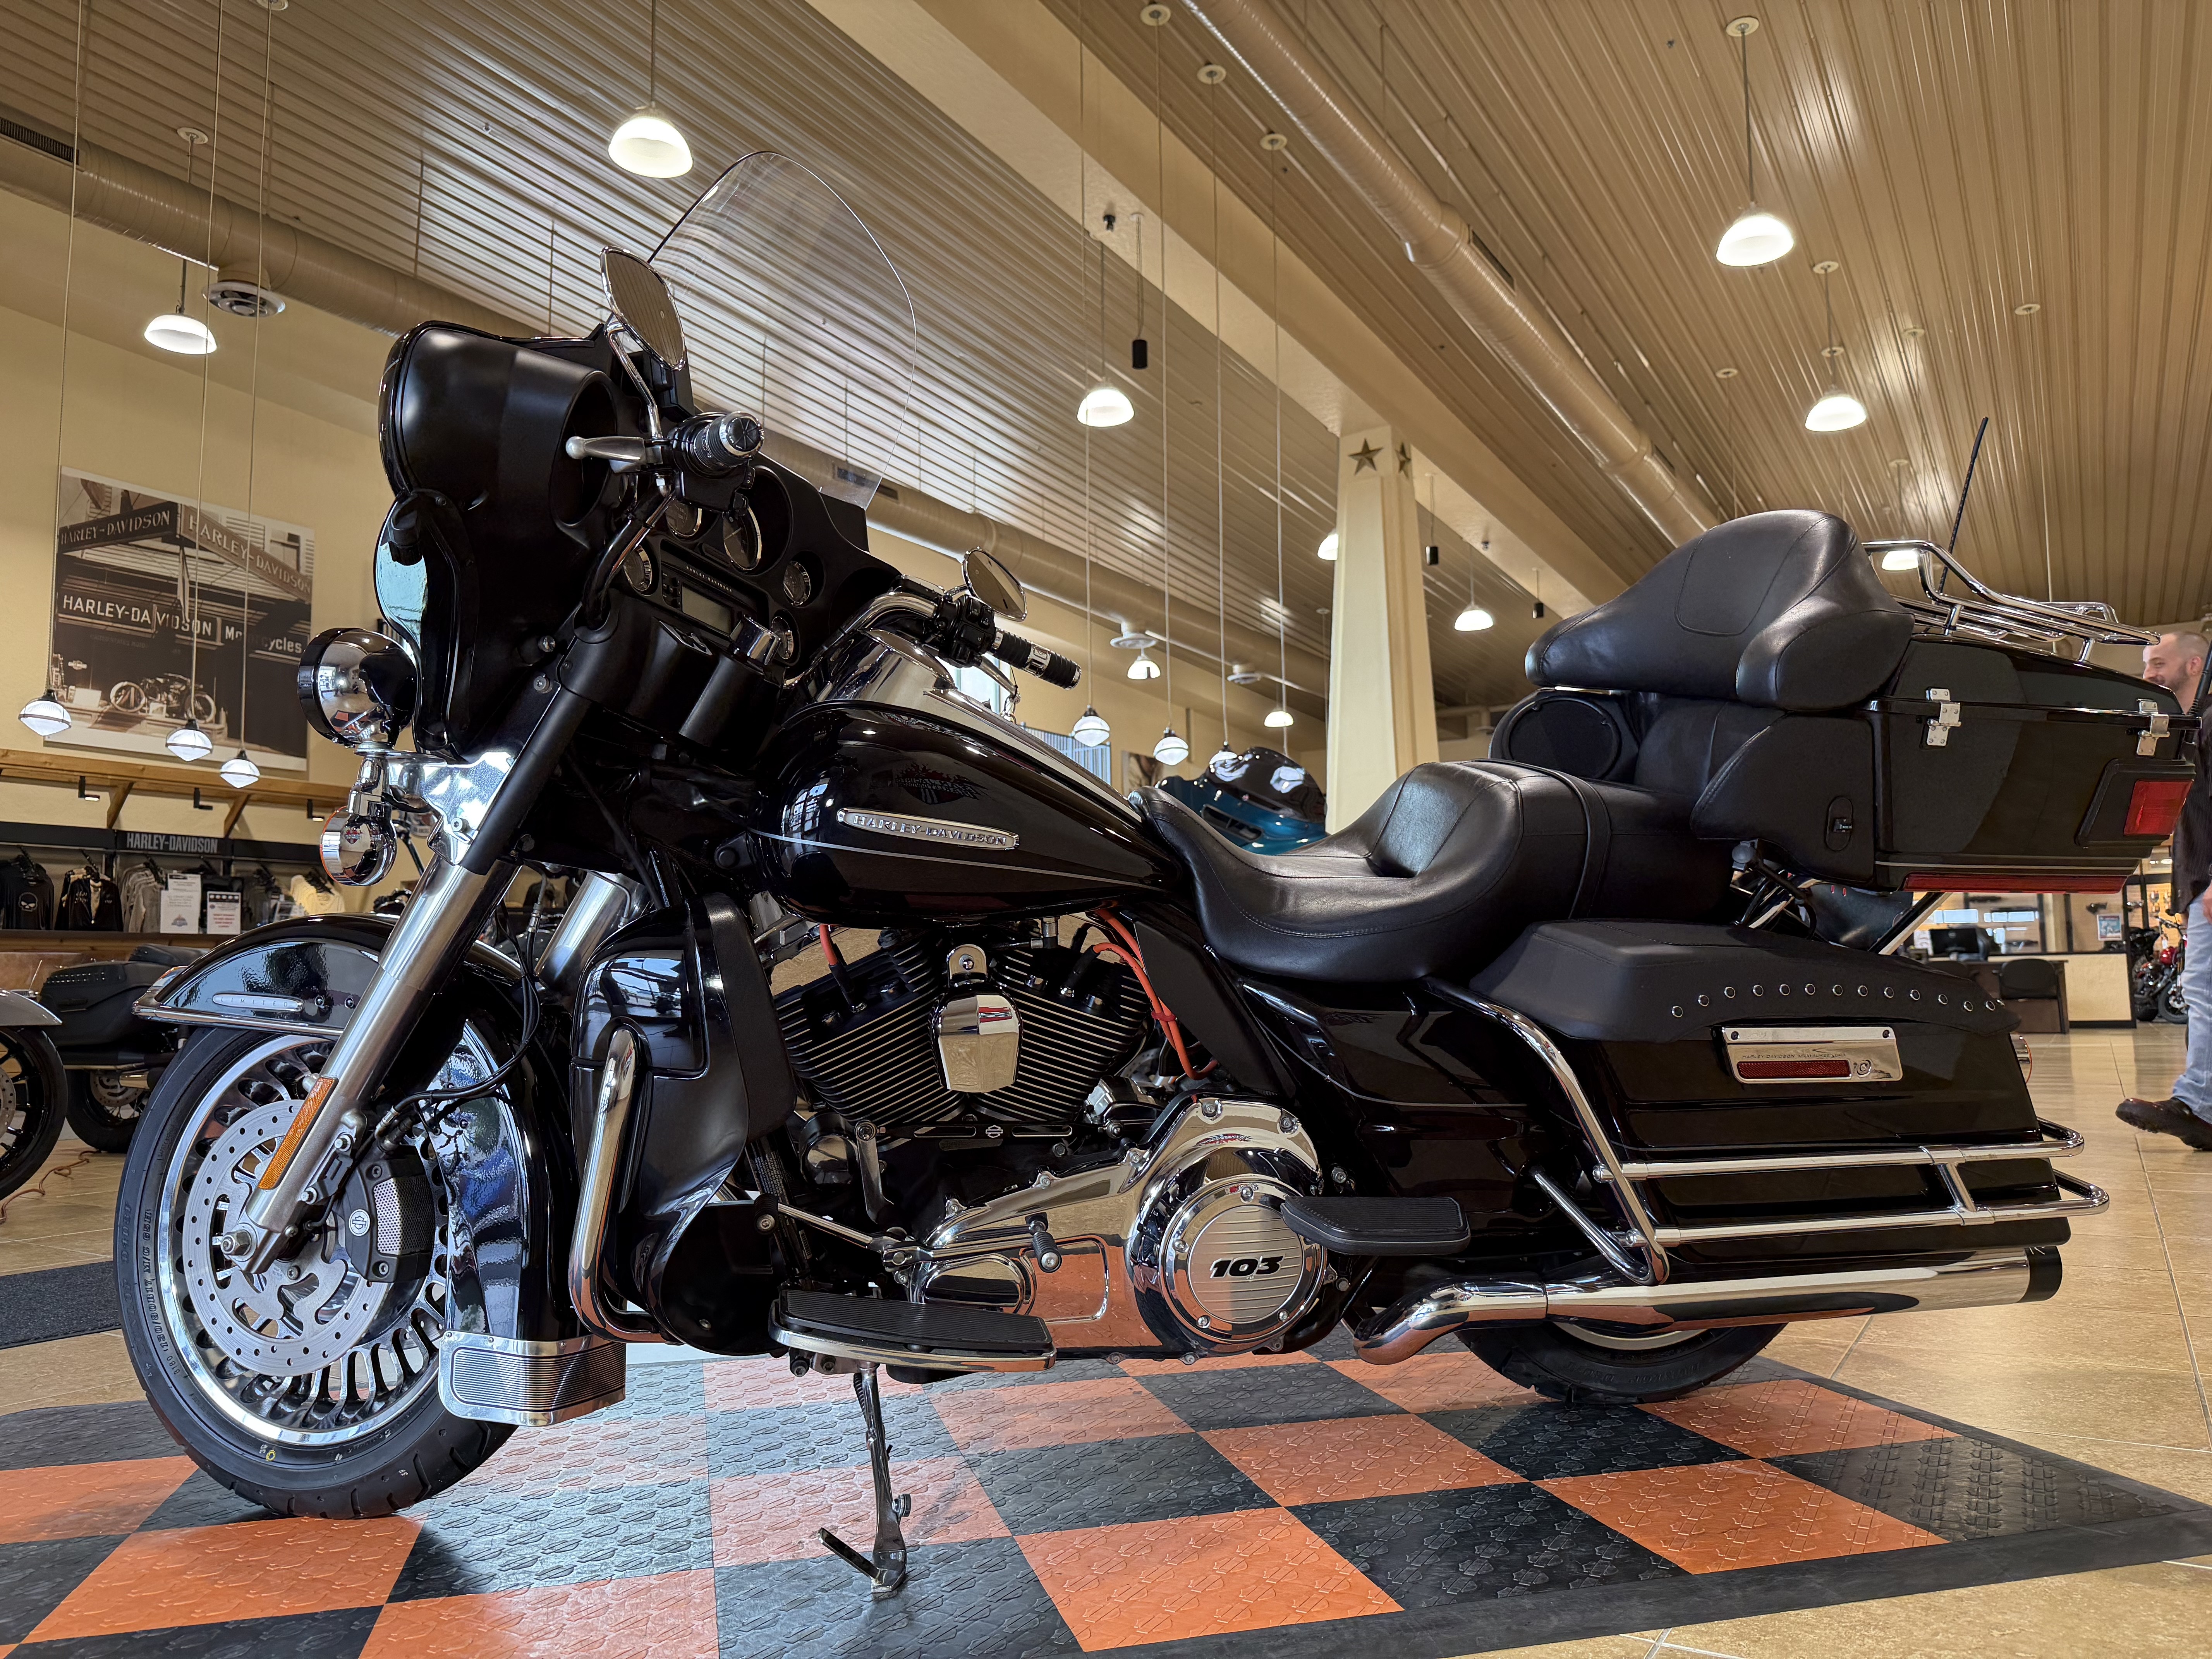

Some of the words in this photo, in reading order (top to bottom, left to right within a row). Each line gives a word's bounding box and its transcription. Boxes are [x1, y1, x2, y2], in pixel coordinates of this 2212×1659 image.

[61, 510, 170, 544] HARLEY-DAVIDSON
[189, 514, 310, 592] HARLEY-DAVIDSON
[63, 595, 211, 636] HARLEY-DAVIDSON
[126, 832, 218, 854] HARLEY-DAVIDSON
[853, 815, 1007, 846] HARLEY-DAVIDSON
[220, 997, 288, 1007] LIMITED
[1210, 1255, 1285, 1279] 103
